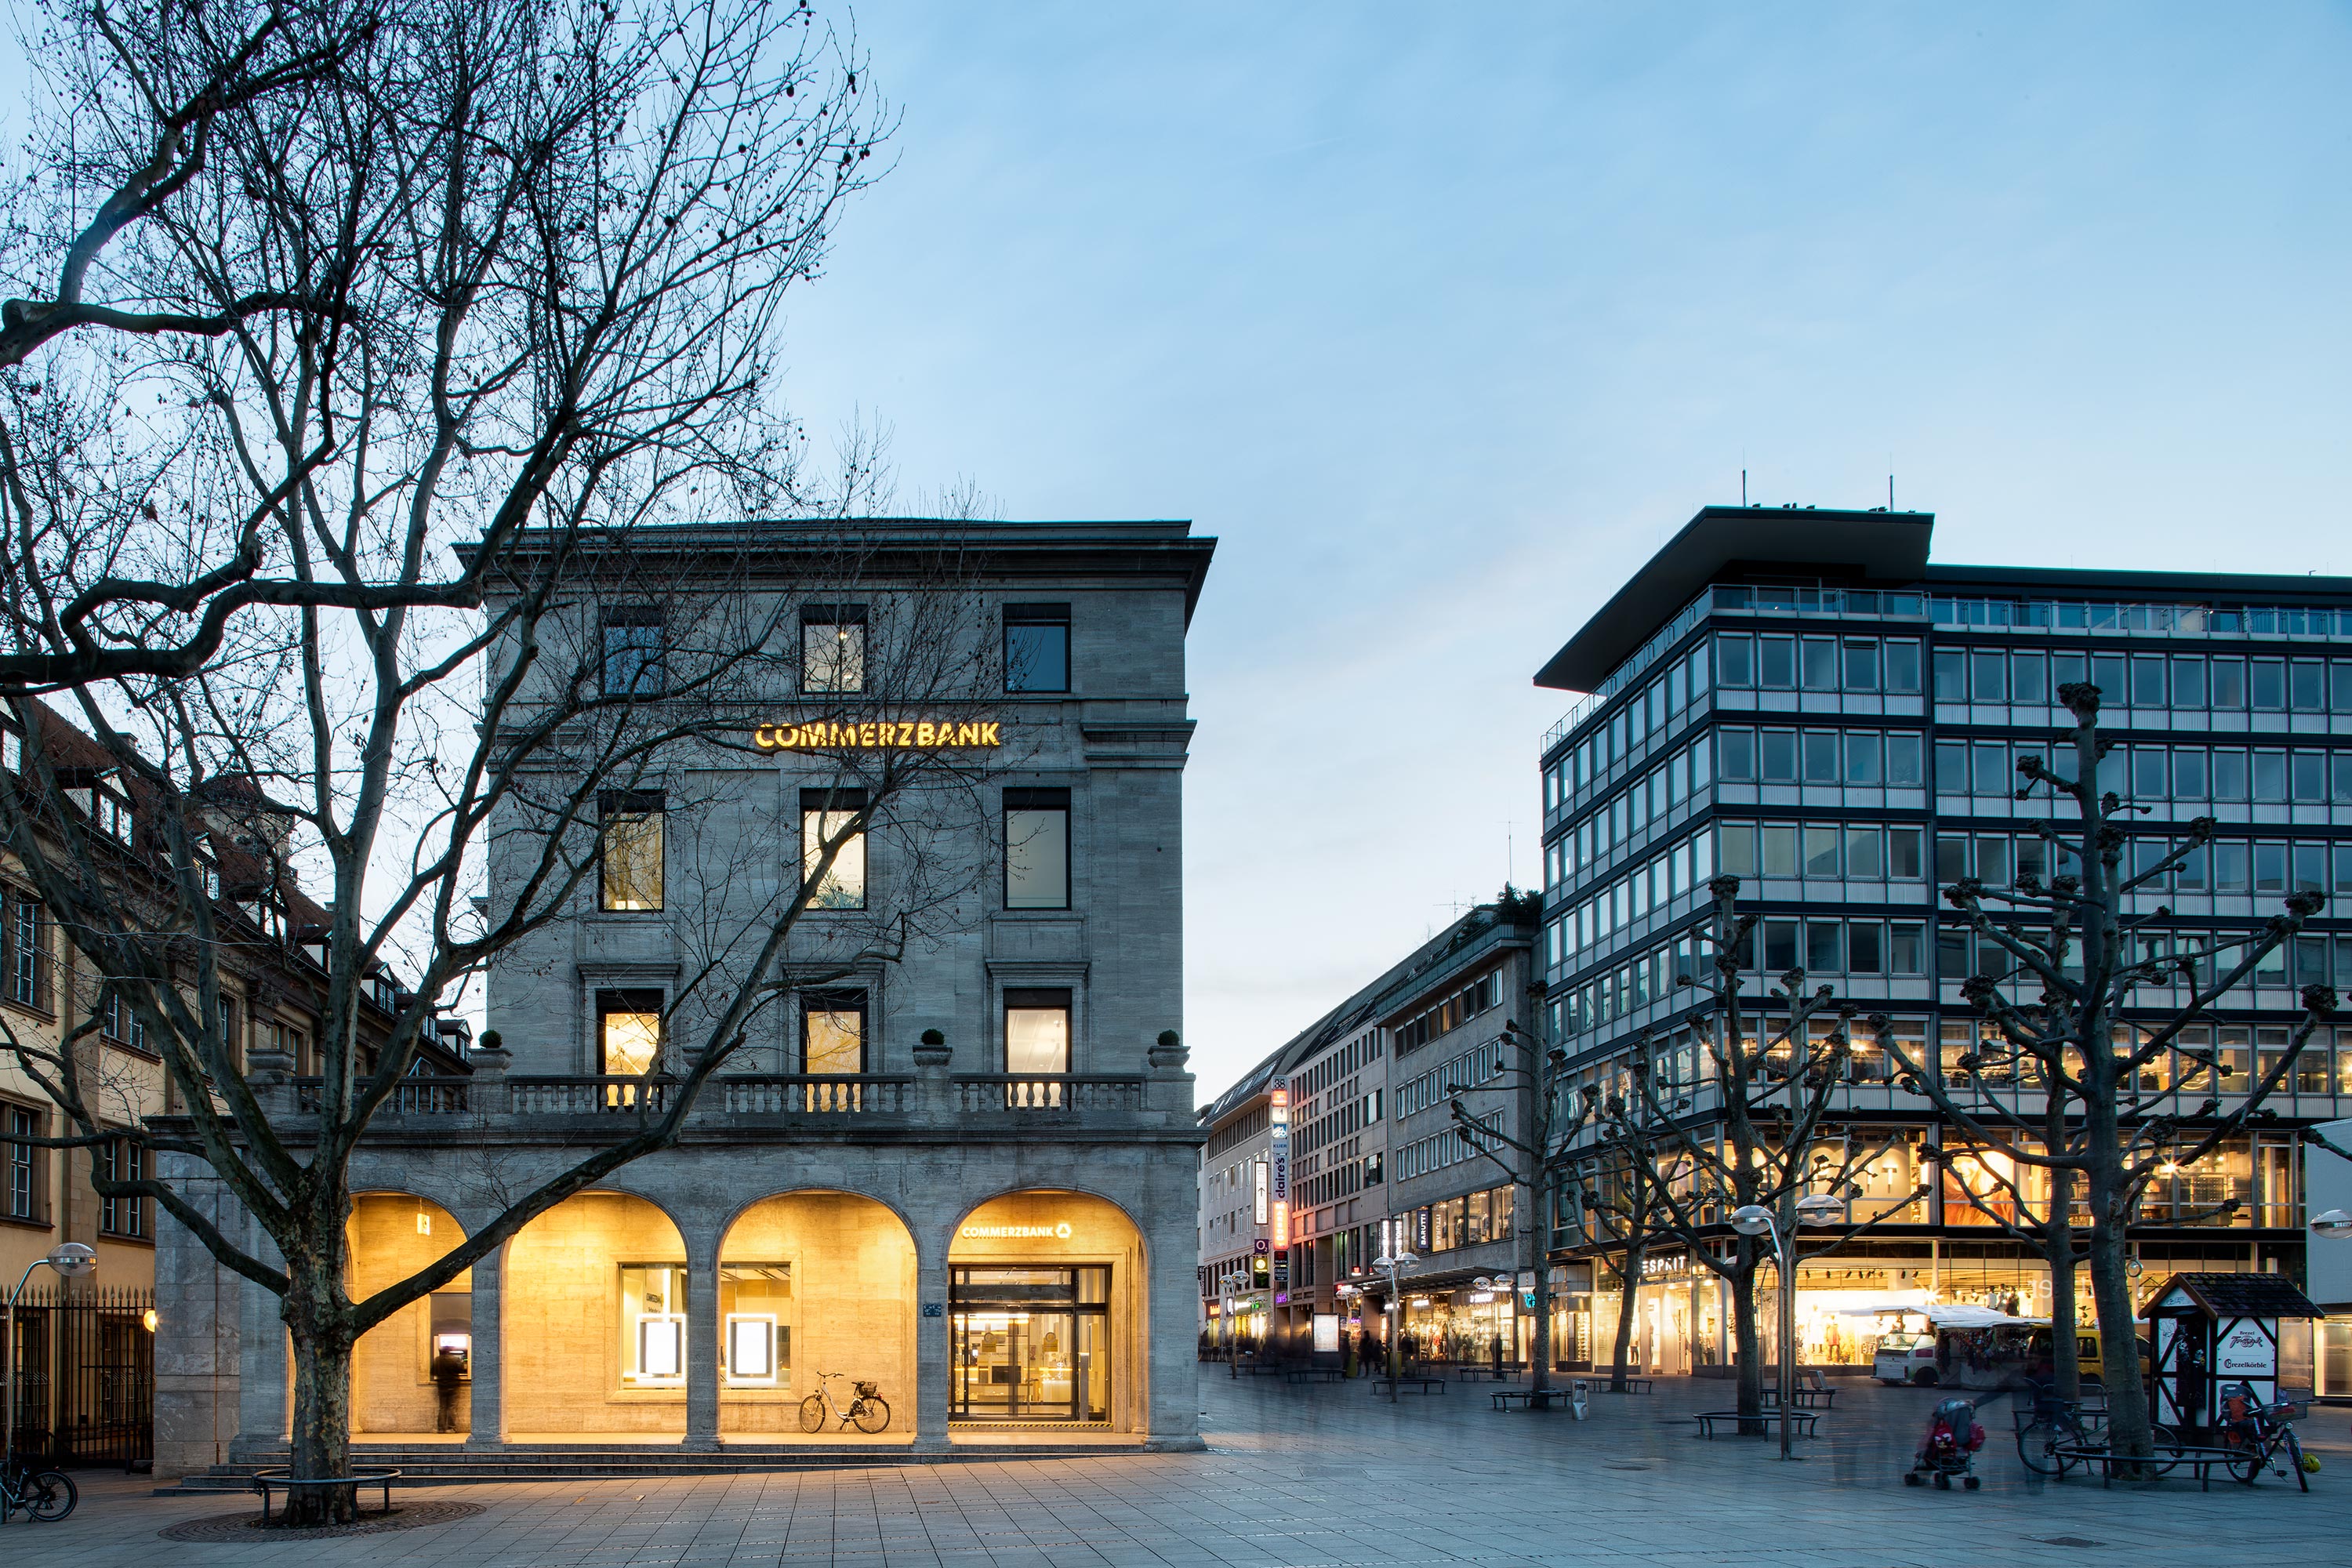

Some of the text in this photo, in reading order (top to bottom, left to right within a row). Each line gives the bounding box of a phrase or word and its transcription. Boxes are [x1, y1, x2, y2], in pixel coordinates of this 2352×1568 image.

[755, 722, 1000, 747] COMMERZBANK
[1274, 1079, 1286, 1089] 38
[1275, 1157, 1285, 1199] claire's
[962, 1226, 1054, 1238] COMMERZBANK
[1642, 1255, 1686, 1274] ESPRIT
[2223, 1358, 2267, 1369] Brezelkörble
